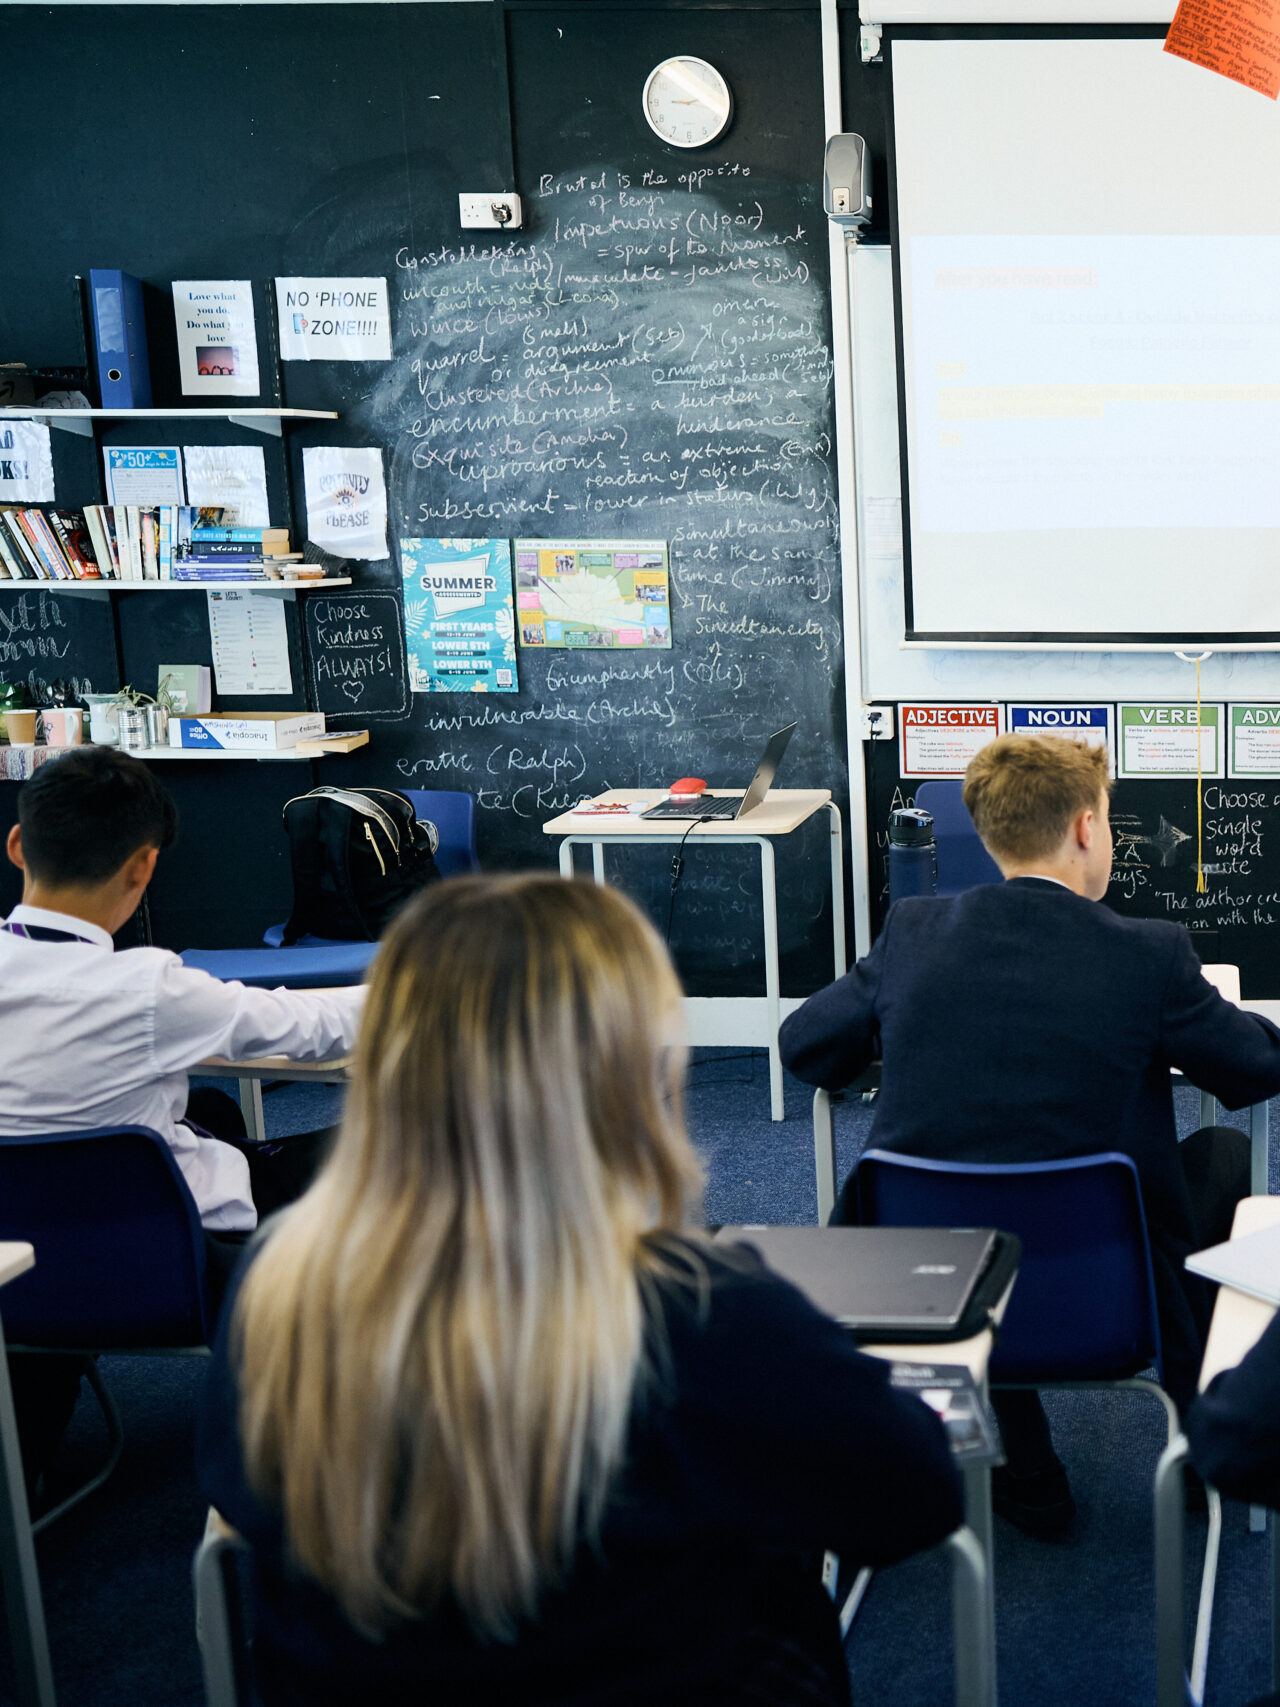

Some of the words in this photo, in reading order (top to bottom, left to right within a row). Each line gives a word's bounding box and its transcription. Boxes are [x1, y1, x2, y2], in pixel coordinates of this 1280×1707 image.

[540, 173, 606, 197] Brutal
[618, 173, 630, 187] is
[643, 170, 667, 185] the
[189, 293, 211, 301] Love
[213, 293, 236, 301] what
[287, 292, 309, 307] NO
[311, 320, 377, 335] ZONE!!!!
[422, 577, 494, 589] SUMMER
[315, 602, 371, 624] Choose
[430, 622, 458, 631] FIRST
[460, 622, 494, 631] YEARS
[317, 625, 383, 646] Kindness
[317, 645, 394, 681] ALWAYS!
[906, 710, 995, 724] ADJECTIVE
[1028, 711, 1091, 725] NOUN
[1139, 709, 1200, 724] VERB
[1204, 787, 1270, 809] Choose
[1215, 835, 1264, 857] word
[1195, 886, 1252, 909] author
